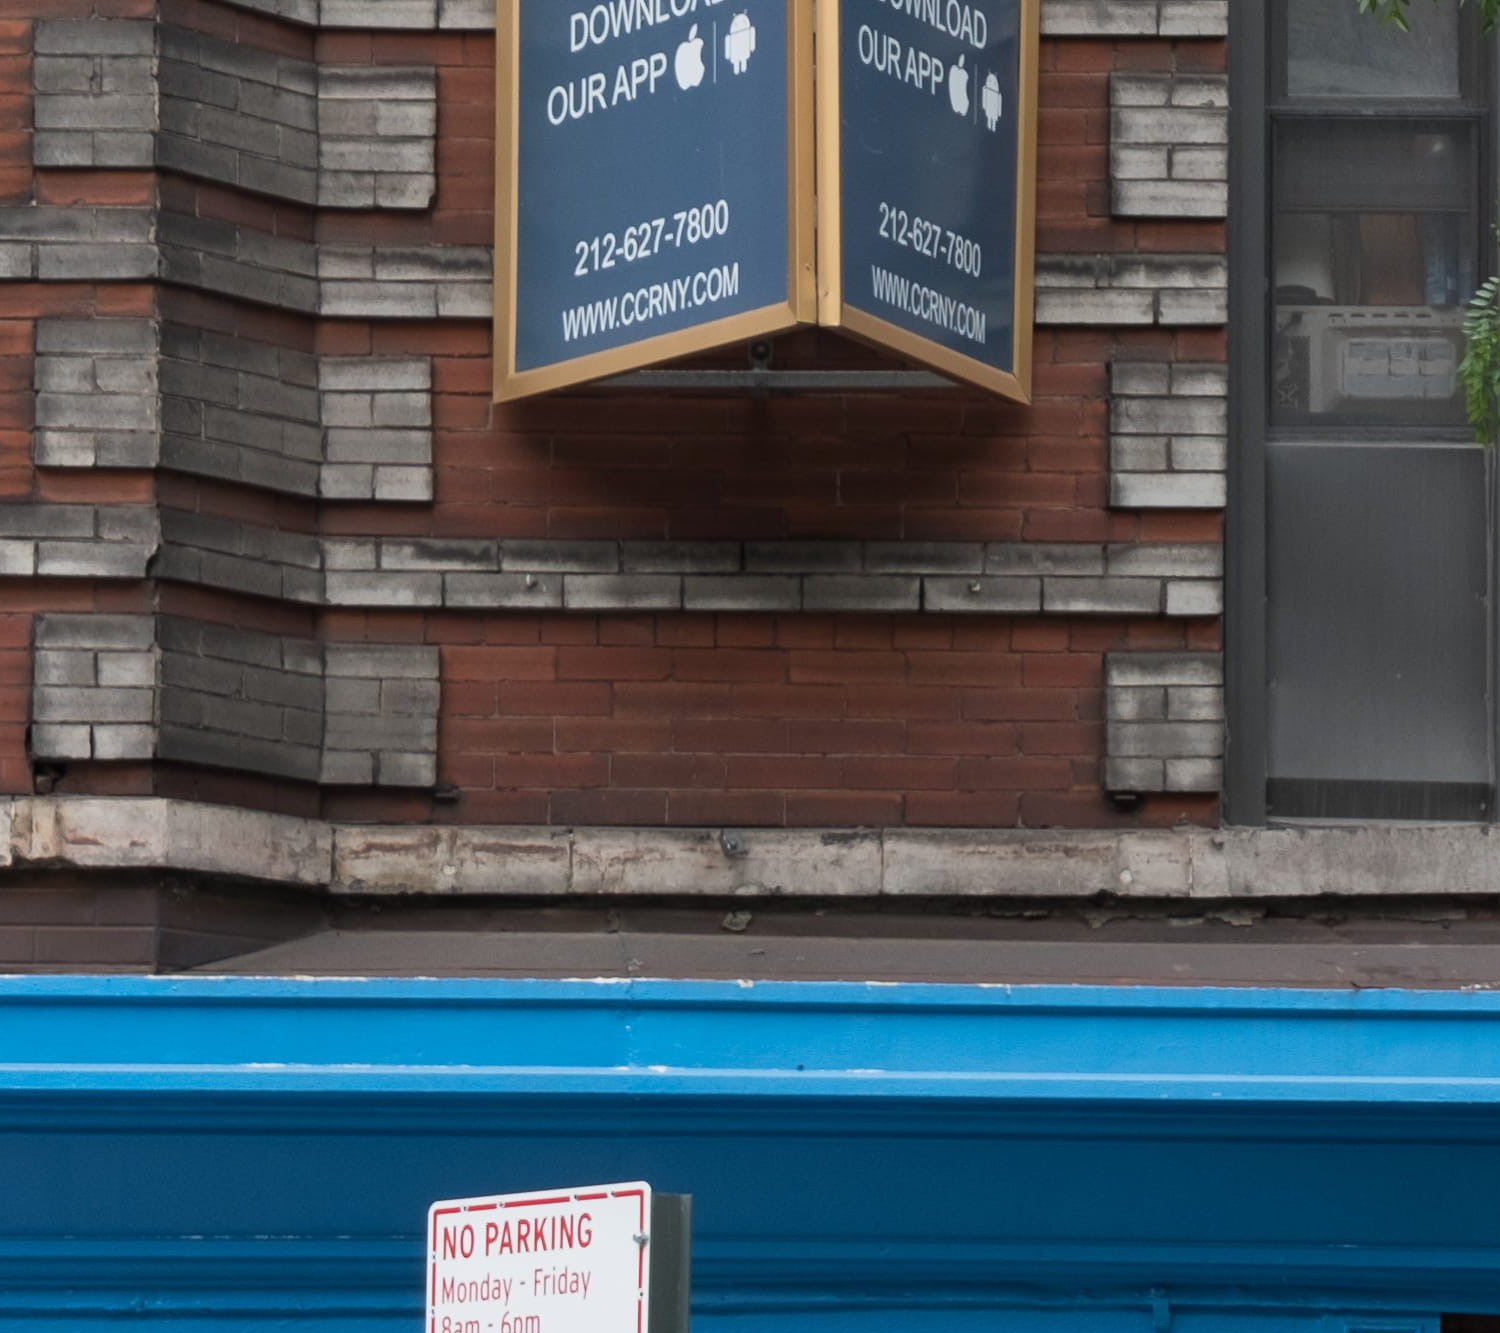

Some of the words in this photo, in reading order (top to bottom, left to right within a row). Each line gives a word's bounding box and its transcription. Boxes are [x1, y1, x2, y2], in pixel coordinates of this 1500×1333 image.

[547, 72, 607, 126] OUR
[611, 52, 668, 106] APP
[858, 24, 902, 80] OUR
[904, 47, 944, 96] APP
[574, 199, 729, 276] 212-627-7800
[879, 202, 981, 278] 212-627-7800
[562, 262, 739, 342] WWW.CCRNY.COM
[871, 264, 986, 344] WWW.CCRNY.COM
[443, 1224, 475, 1260] NO
[485, 1213, 593, 1257] PARKING
[442, 1273, 512, 1306] Monday
[534, 1266, 591, 1300] Friday
